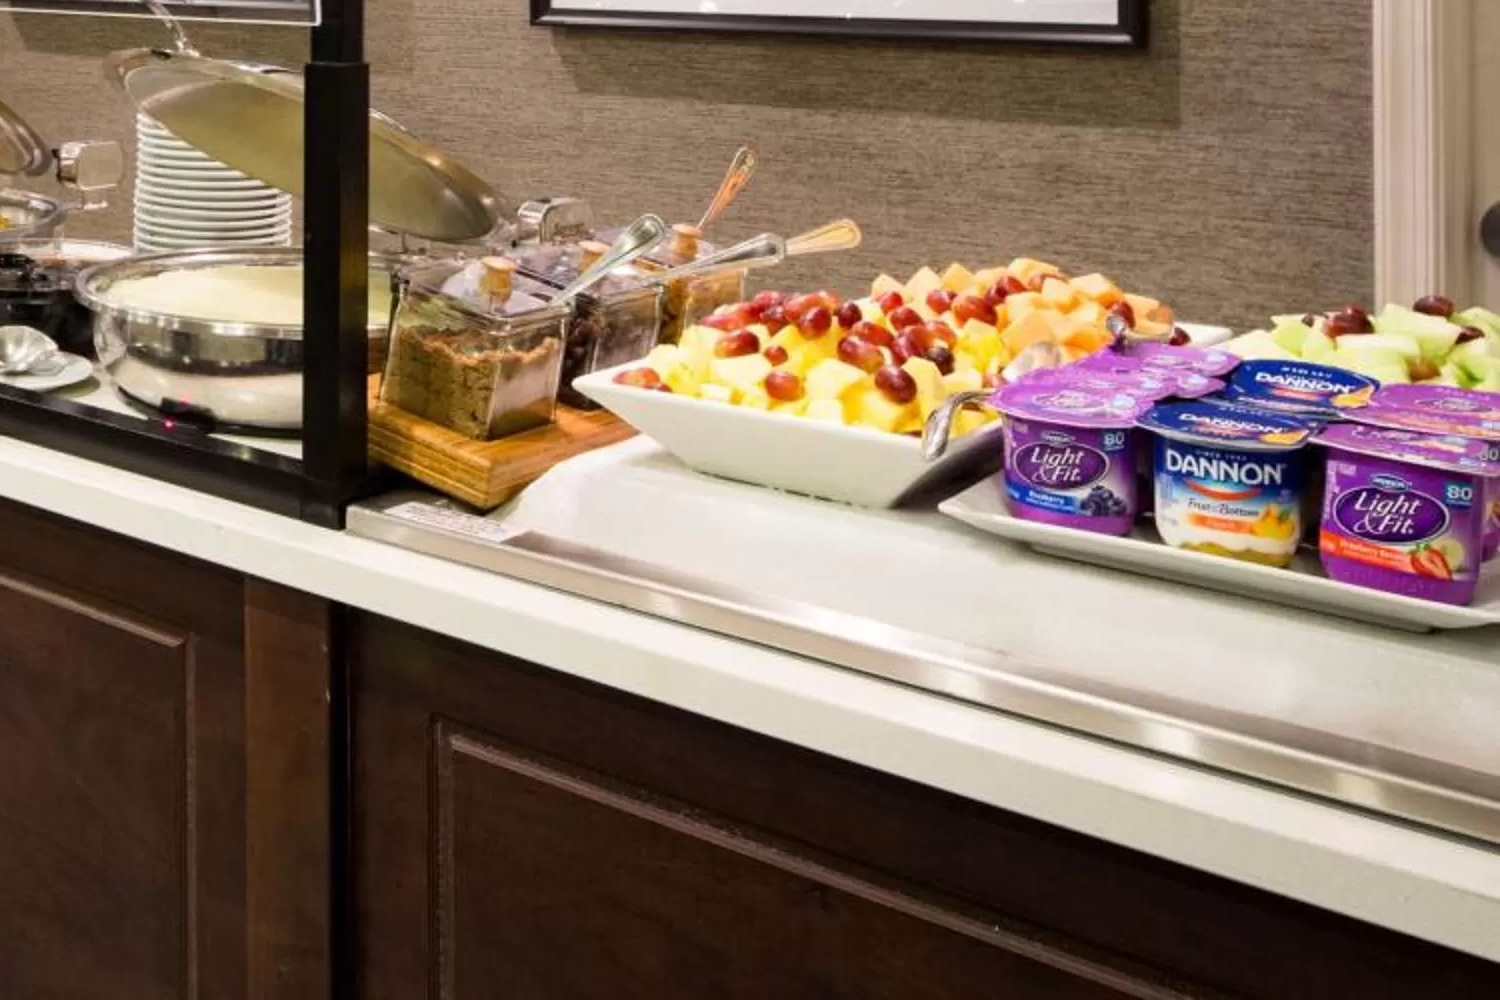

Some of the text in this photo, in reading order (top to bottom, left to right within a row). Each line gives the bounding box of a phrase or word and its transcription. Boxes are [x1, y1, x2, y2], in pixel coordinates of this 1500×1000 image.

[1255, 371, 1350, 394] DANNON
[1104, 432, 1125, 447] 80
[1031, 447, 1084, 469] Light
[1166, 449, 1282, 485] DANNON
[1446, 485, 1473, 501] 80
[1354, 491, 1422, 518] Light
[1378, 515, 1414, 535] Fit
